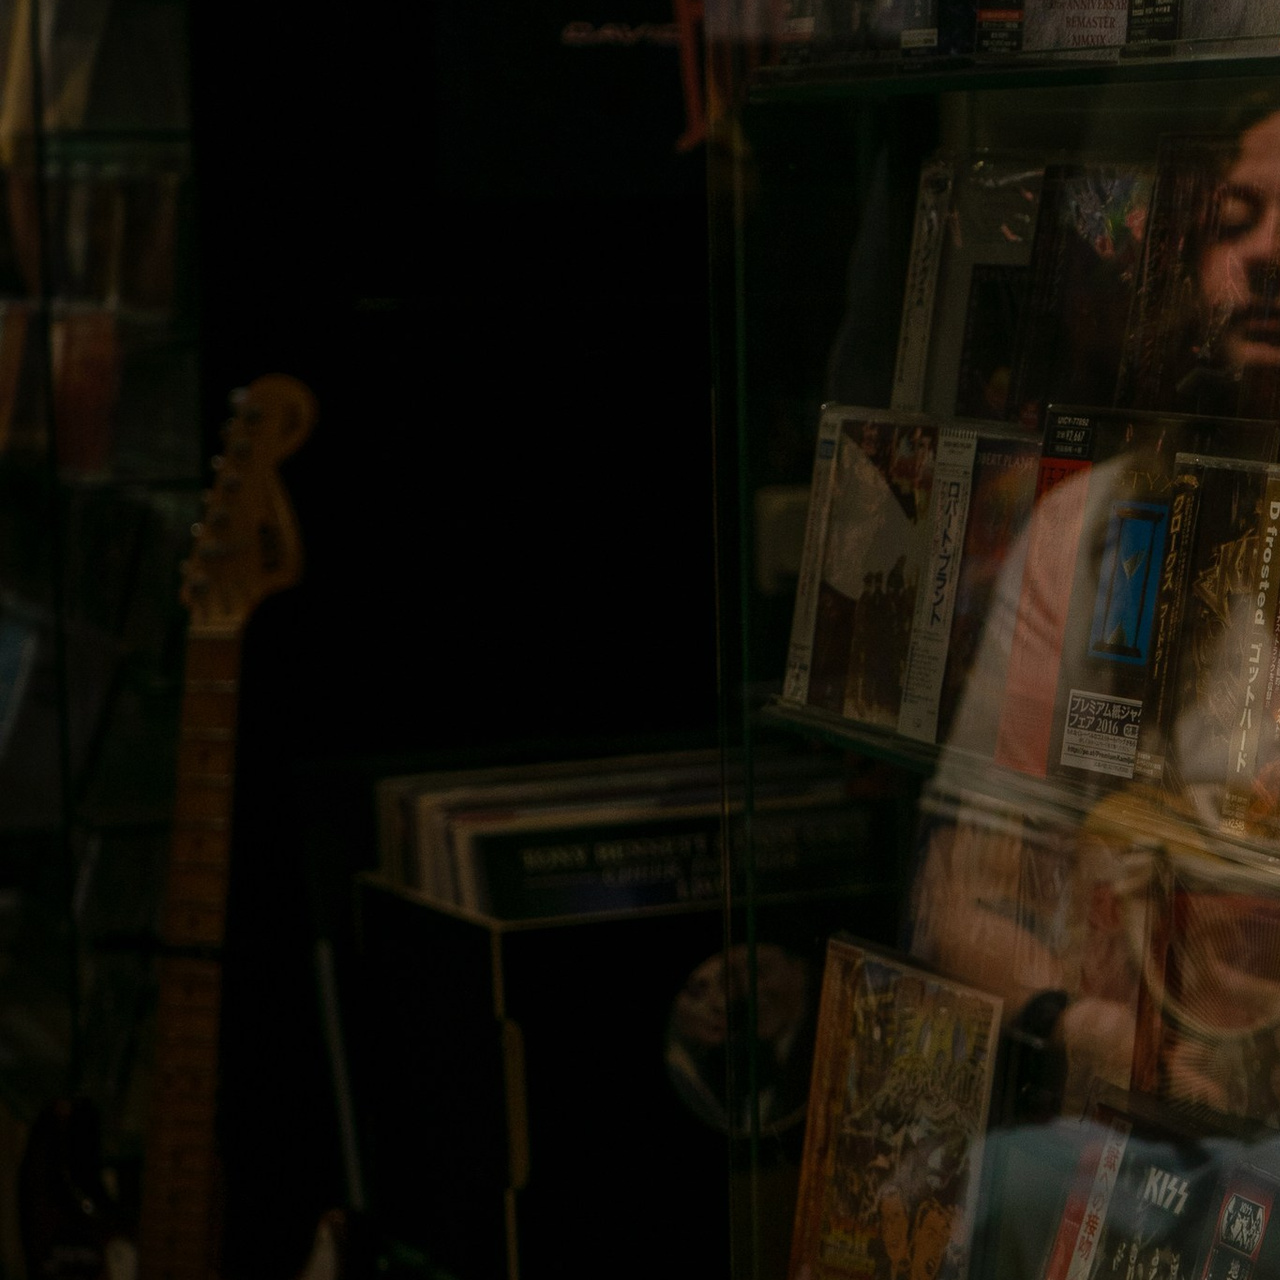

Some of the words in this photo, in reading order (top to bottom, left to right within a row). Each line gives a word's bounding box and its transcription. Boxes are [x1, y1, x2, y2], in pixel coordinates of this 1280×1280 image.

[1066, 16, 1117, 29] REMASTER
[931, 480, 962, 626] ロバート・プラント
[1253, 529, 1279, 627] frosted
[1069, 712, 1096, 729] フェア
[1095, 717, 1119, 735] 2016
[1235, 641, 1264, 774] ゴットハード
[1143, 1167, 1189, 1215] KISS
